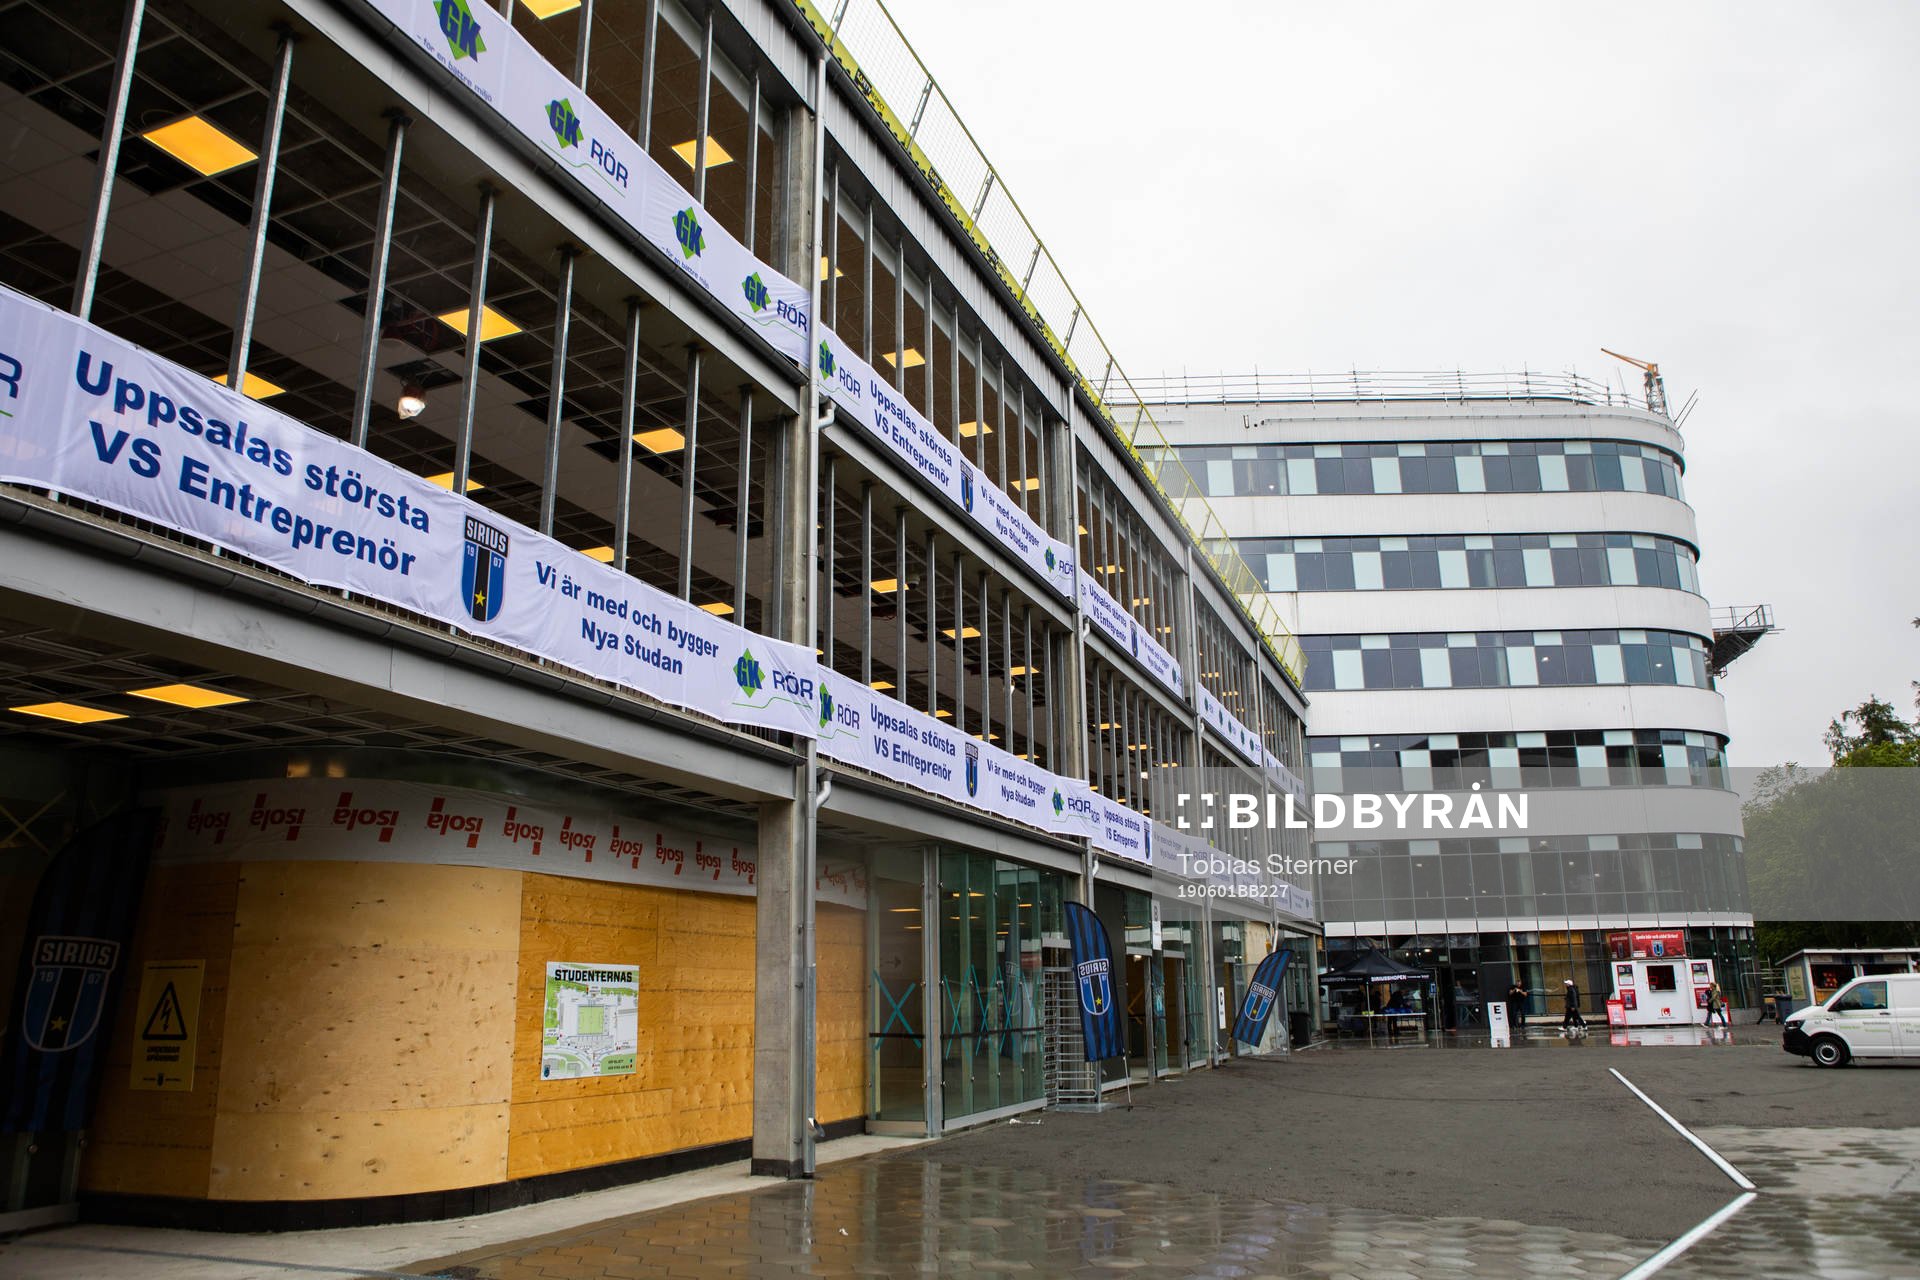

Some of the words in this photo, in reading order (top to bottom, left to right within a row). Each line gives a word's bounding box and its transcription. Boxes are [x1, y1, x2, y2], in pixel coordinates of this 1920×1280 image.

[439, 0, 481, 62] GK
[549, 100, 580, 149] GK
[590, 138, 628, 188] RÖR
[676, 210, 702, 258] GK
[744, 275, 767, 310] GK
[777, 299, 807, 333] RÖR
[839, 366, 861, 398] RÖR
[870, 379, 917, 435] Uppsalas
[920, 430, 952, 467] största
[76, 350, 293, 476] Uppsalas
[304, 463, 430, 534] största
[874, 409, 889, 434] VS
[892, 424, 950, 487] Entreprenör
[89, 420, 163, 479] VS
[179, 456, 416, 577] Entreprenör
[466, 518, 507, 554] SIRIUS
[995, 517, 1008, 536] Nya
[466, 544, 475, 557] 19
[493, 556, 503, 569] 07
[535, 560, 556, 590] Vi
[561, 574, 581, 600] är
[587, 590, 628, 620] med
[632, 607, 662, 636] och
[668, 620, 719, 659] bygger
[581, 618, 619, 651] Nya
[625, 634, 683, 675] Studan
[736, 656, 763, 690] GK
[773, 668, 814, 700] RÖR
[837, 703, 860, 730] RÖR
[870, 703, 918, 741] Uppsalas
[921, 729, 956, 757] största
[874, 735, 889, 758] VS
[892, 744, 952, 782] Entreprenör
[986, 758, 993, 772] Vi
[1002, 768, 1016, 782] med
[1028, 776, 1046, 795] bygger
[1001, 785, 1015, 801] Nya
[1015, 791, 1036, 808] Studan
[1067, 797, 1091, 813] RÖR
[251, 808, 305, 841] isola
[333, 807, 399, 842] isola
[427, 812, 483, 848] isola
[503, 821, 544, 855] isola
[559, 828, 597, 862] isola
[609, 837, 643, 869] isola
[656, 844, 684, 875] isola
[41, 942, 111, 966] SIRIUS
[40, 971, 54, 983] 19
[555, 969, 633, 983] STUDENTERNAS
[1253, 984, 1273, 999] SIRIUS
